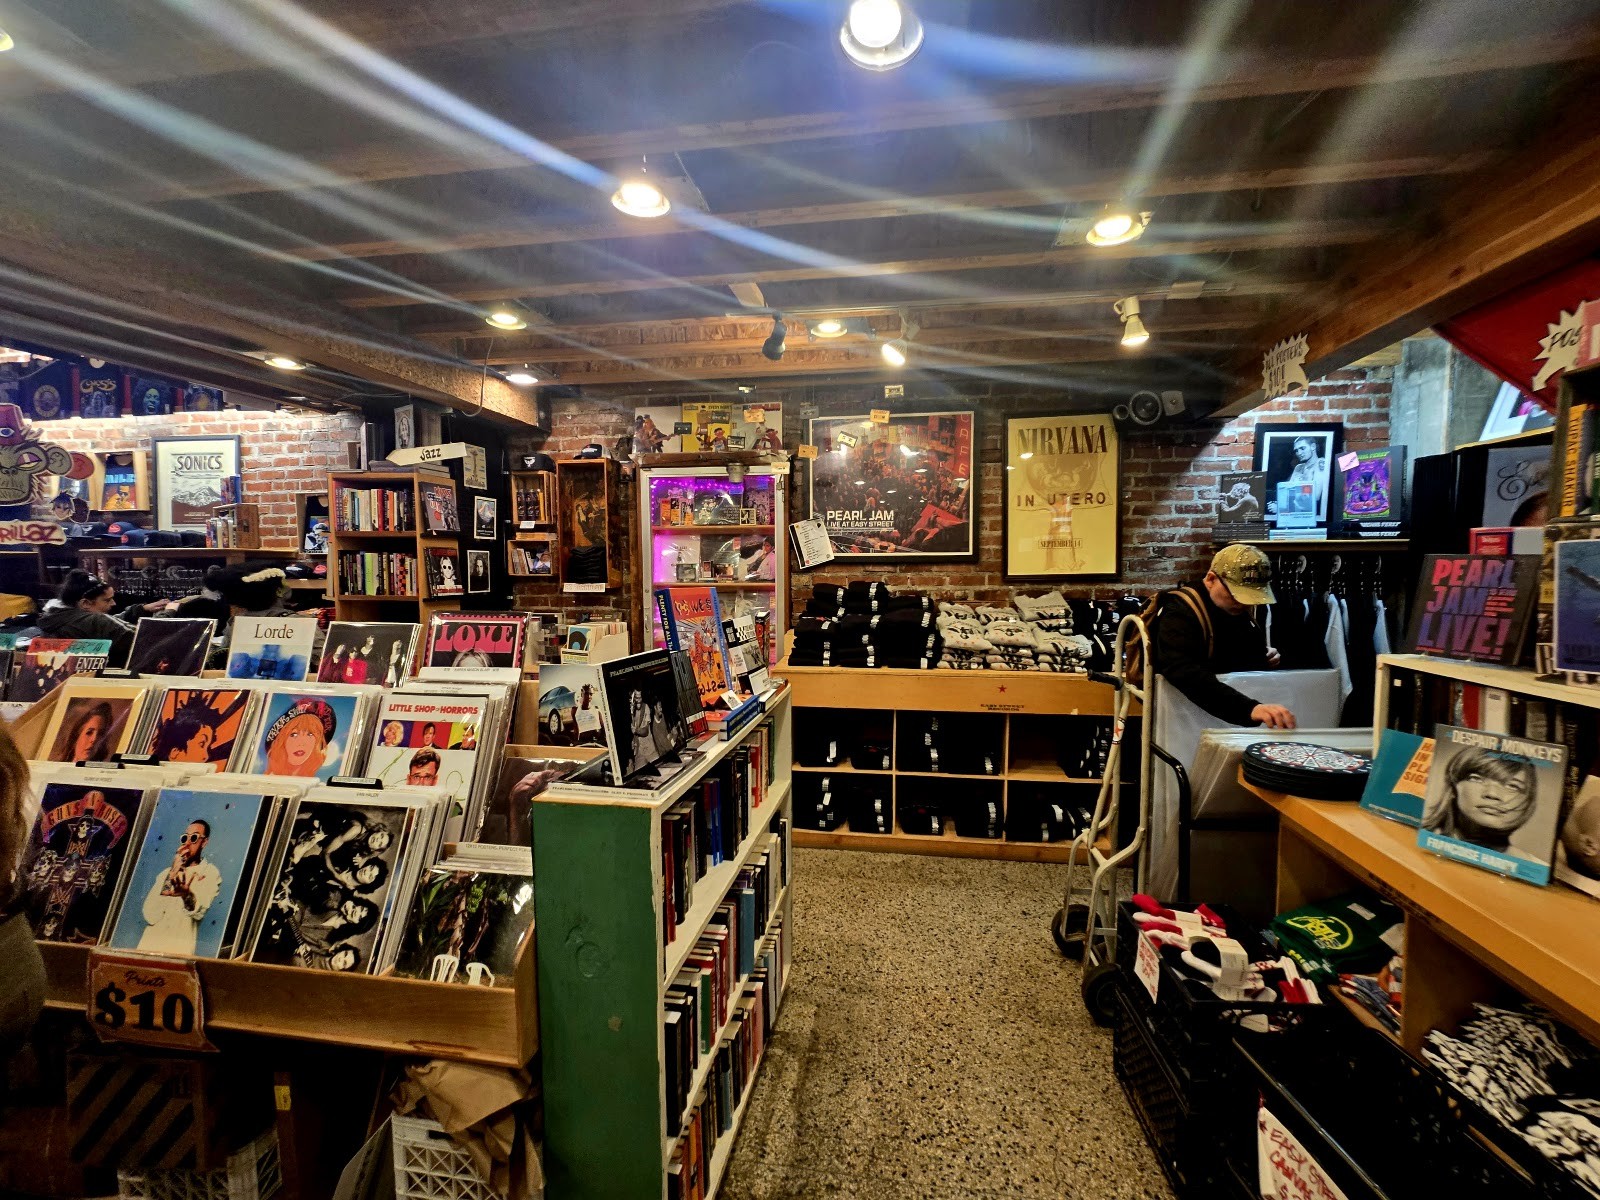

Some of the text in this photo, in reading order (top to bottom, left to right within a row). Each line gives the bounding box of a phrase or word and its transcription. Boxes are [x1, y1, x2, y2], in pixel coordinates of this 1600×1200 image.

[1017, 425, 1108, 456] NIRVANA
[420, 448, 442, 461] Jazz
[1562, 418, 1580, 507] TUPAC SHAKUR
[1017, 491, 1107, 507] IN UTERO
[826, 510, 895, 521] PEARL JAM
[1040, 540, 1073, 548] SEPTEMBER
[1431, 559, 1516, 588] PEARL
[658, 594, 668, 617] PLENTY
[1426, 586, 1490, 615] JAM
[254, 623, 294, 639] Lorde
[435, 624, 514, 654] LOVE
[1416, 612, 1513, 655] LIVE!
[76, 656, 105, 671] ENTER
[388, 704, 413, 713] LITTLE
[414, 705, 436, 713] SHOP
[440, 706, 479, 715] HORRORS
[1451, 729, 1498, 751] DESPAIR
[1500, 738, 1563, 763] MONKEYS
[124, 970, 166, 987] Prints
[95, 981, 195, 1034] $10
